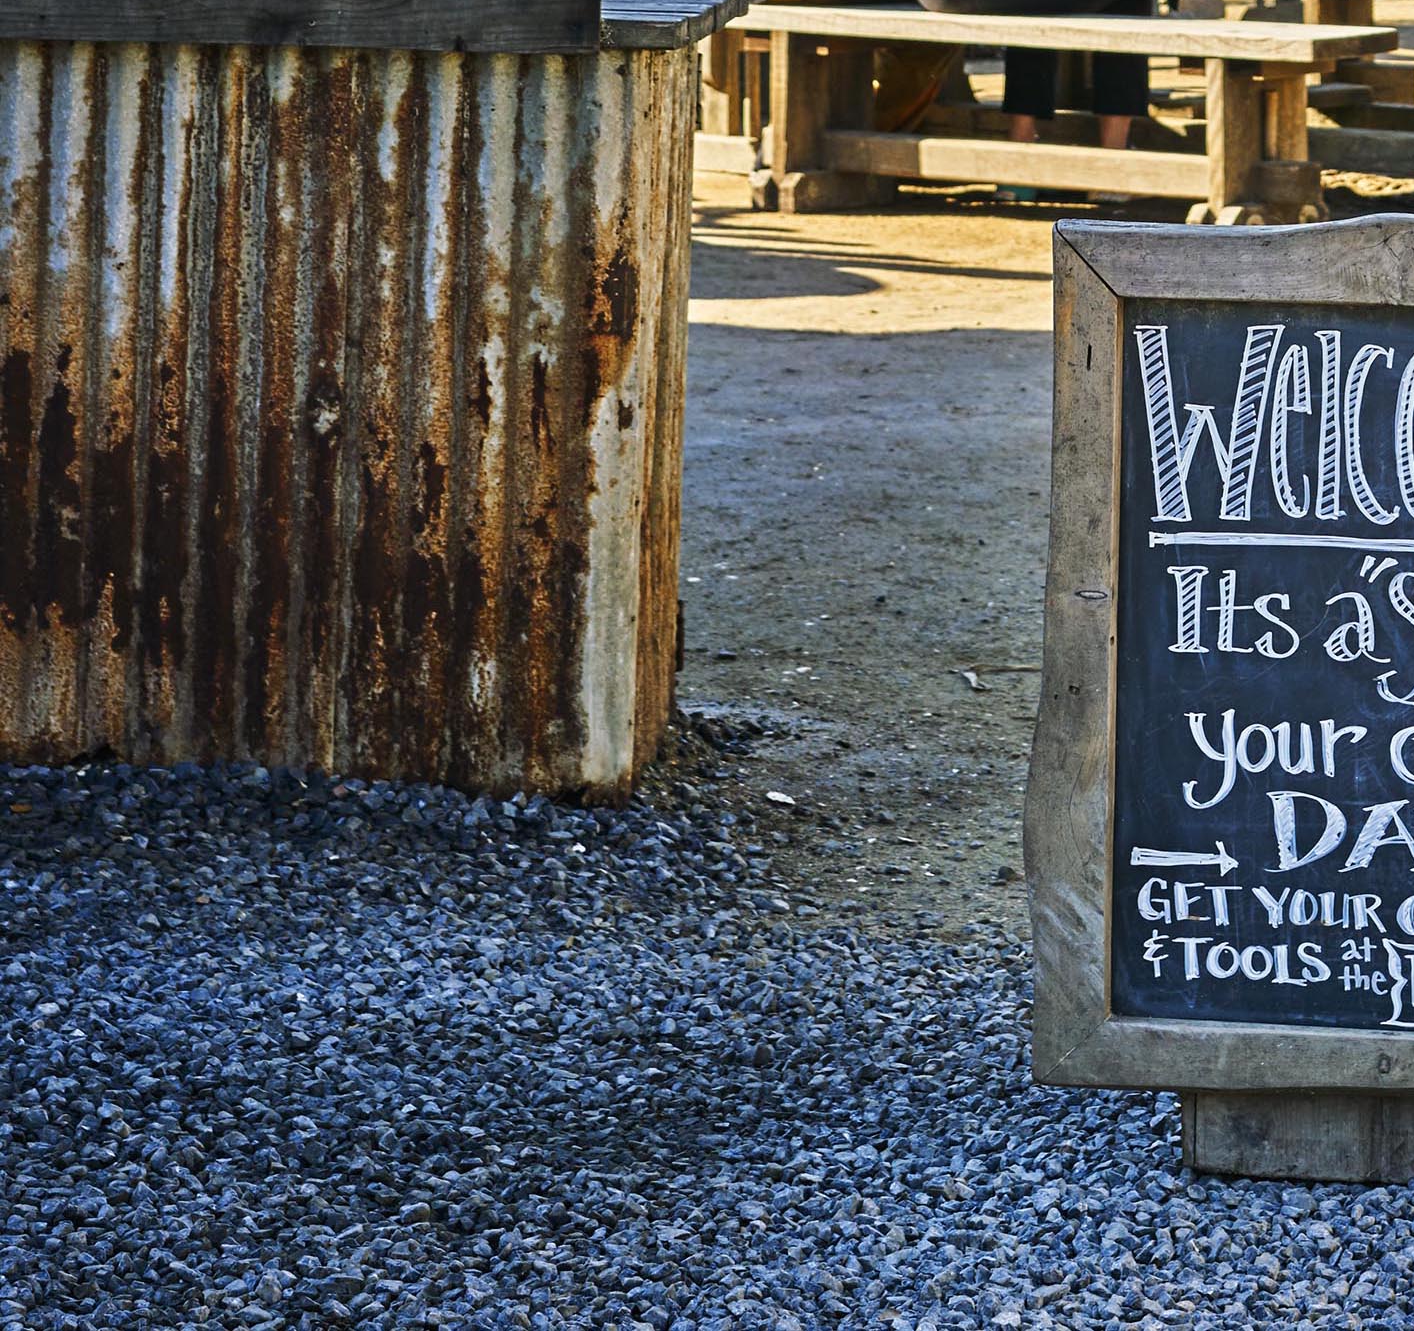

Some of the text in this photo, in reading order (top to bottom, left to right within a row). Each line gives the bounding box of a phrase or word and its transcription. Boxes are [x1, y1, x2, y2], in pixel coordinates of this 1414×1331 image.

[1166, 565, 1301, 659] Its
[1322, 591, 1391, 664] a
[1182, 708, 1368, 810] your
[1137, 877, 1243, 927] GET
[1251, 885, 1387, 934] YOUR
[1142, 928, 1332, 987] & TOOLS
[1340, 936, 1378, 963] at
[1337, 963, 1389, 996] the
